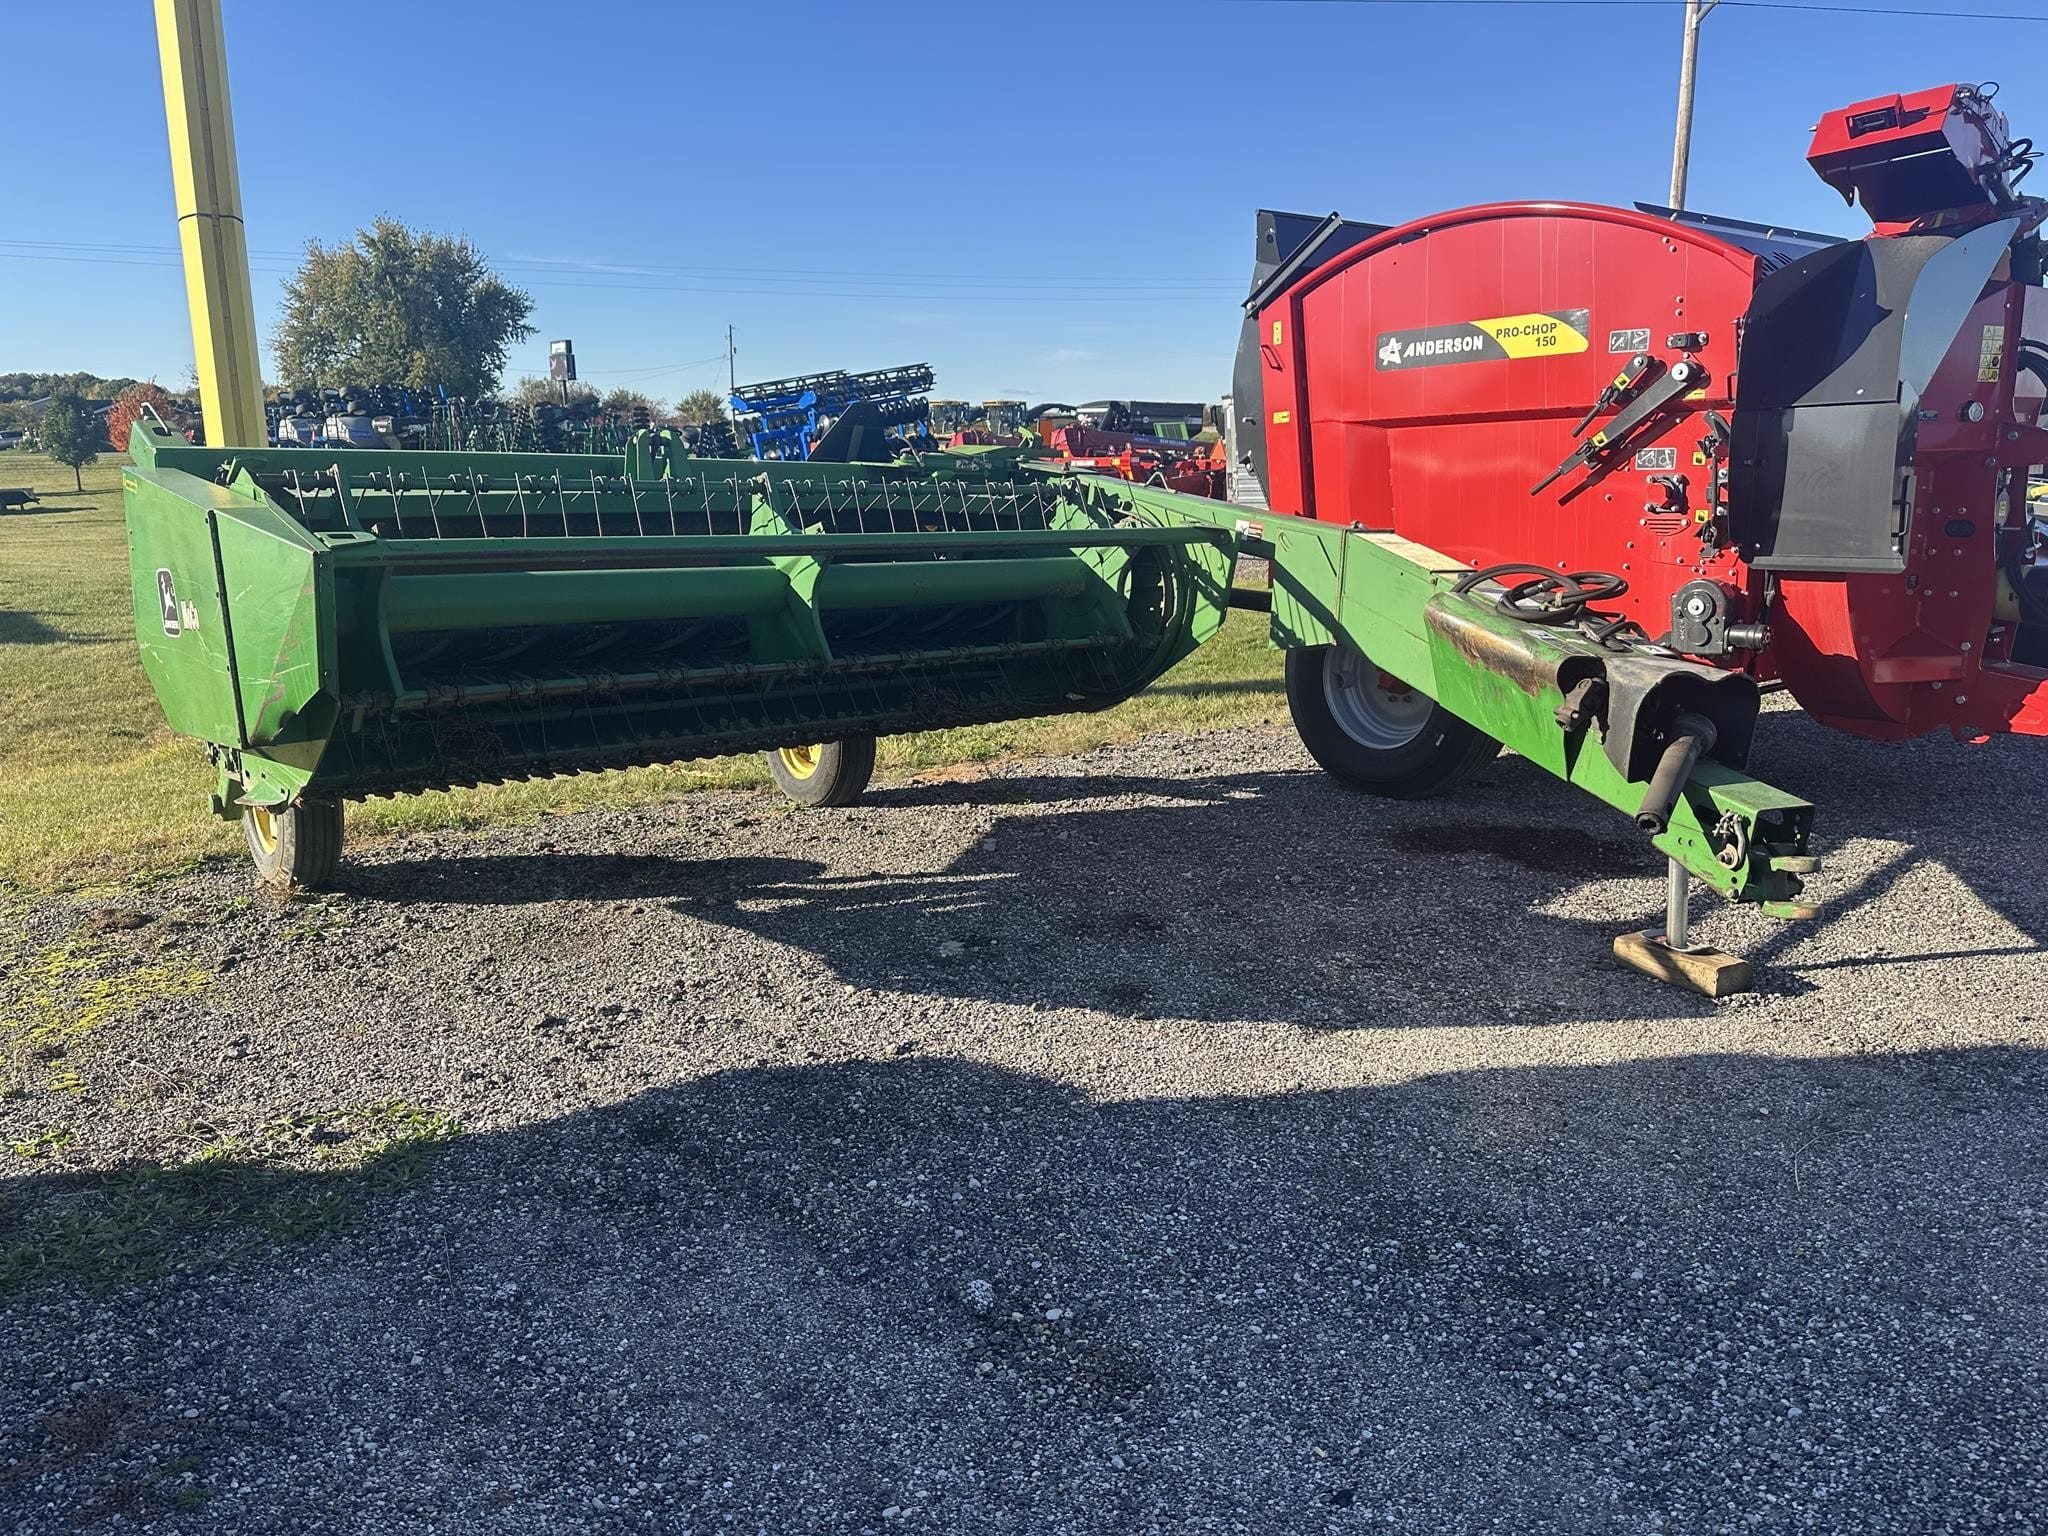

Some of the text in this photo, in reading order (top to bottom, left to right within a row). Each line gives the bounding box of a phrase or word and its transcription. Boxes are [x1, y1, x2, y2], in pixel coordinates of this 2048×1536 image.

[1496, 323, 1557, 338] PRO-CHOP
[1403, 336, 1482, 357] ANDERSON
[1535, 336, 1556, 347] 150
